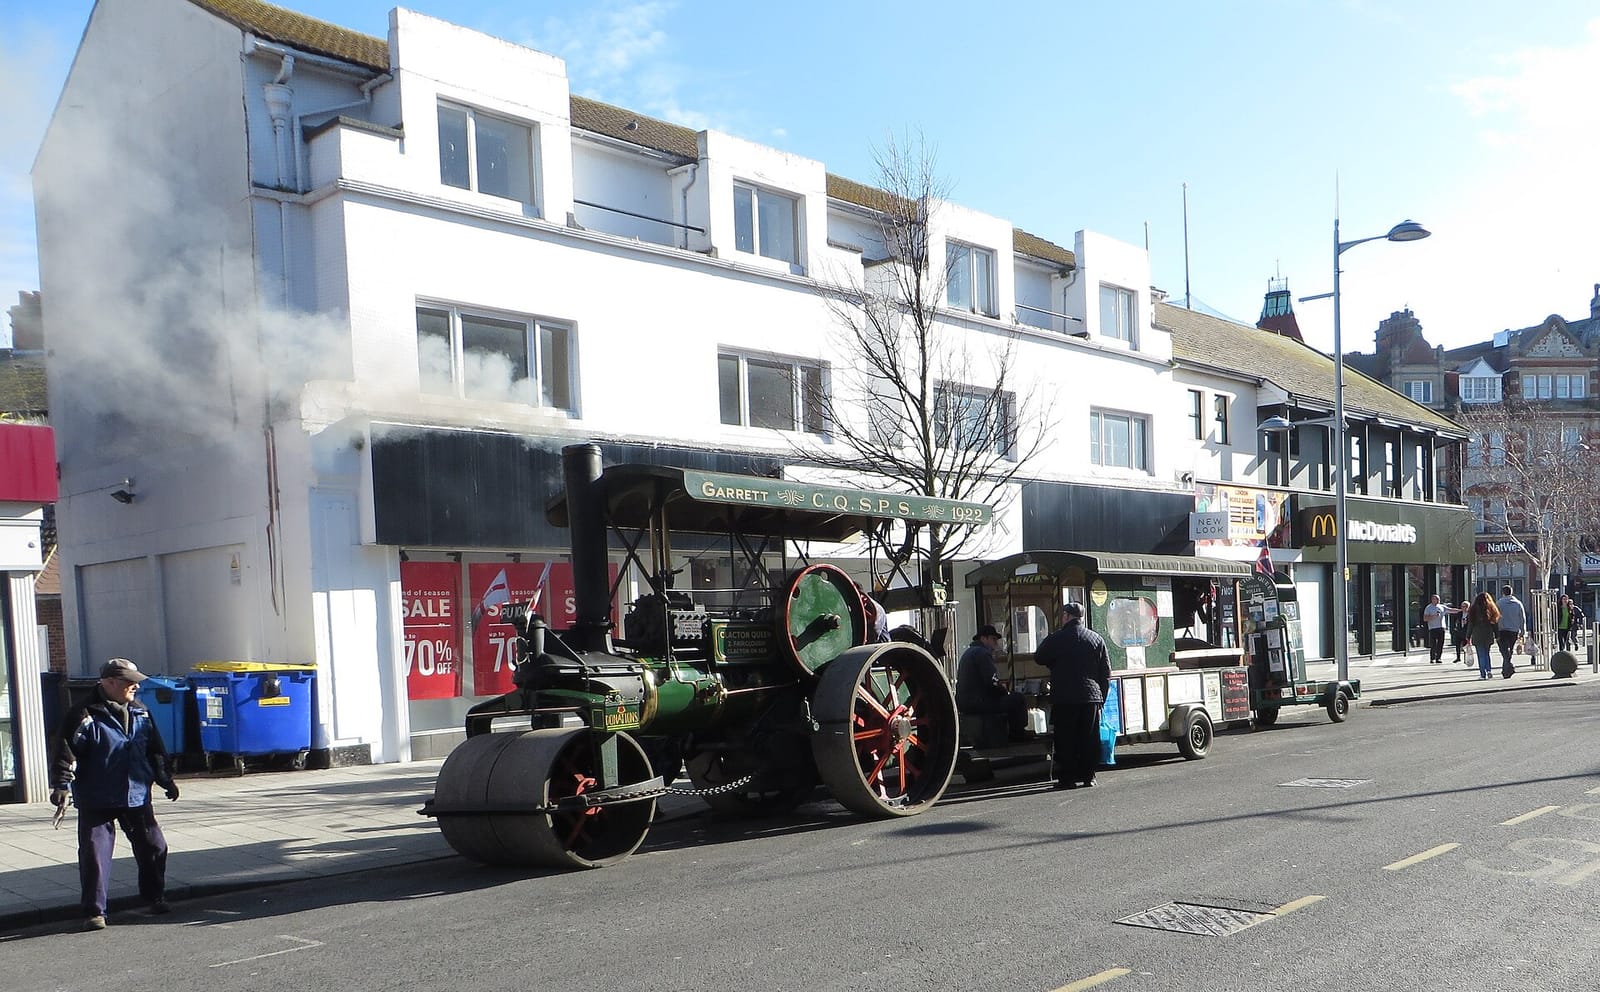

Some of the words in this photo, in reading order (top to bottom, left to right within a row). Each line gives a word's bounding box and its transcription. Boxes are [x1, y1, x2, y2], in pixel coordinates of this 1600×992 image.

[702, 481, 769, 501] GARRETT
[950, 506, 983, 523] 1922
[1198, 518, 1222, 526] NEW
[1196, 526, 1224, 534] LOOK
[1347, 519, 1417, 543] McDonald's
[1257, 576, 1275, 596] QUEEN
[402, 599, 451, 618] SALE
[719, 631, 750, 639] CLACTON
[437, 662, 452, 674] OFF
[605, 712, 639, 726] DONATIONS
